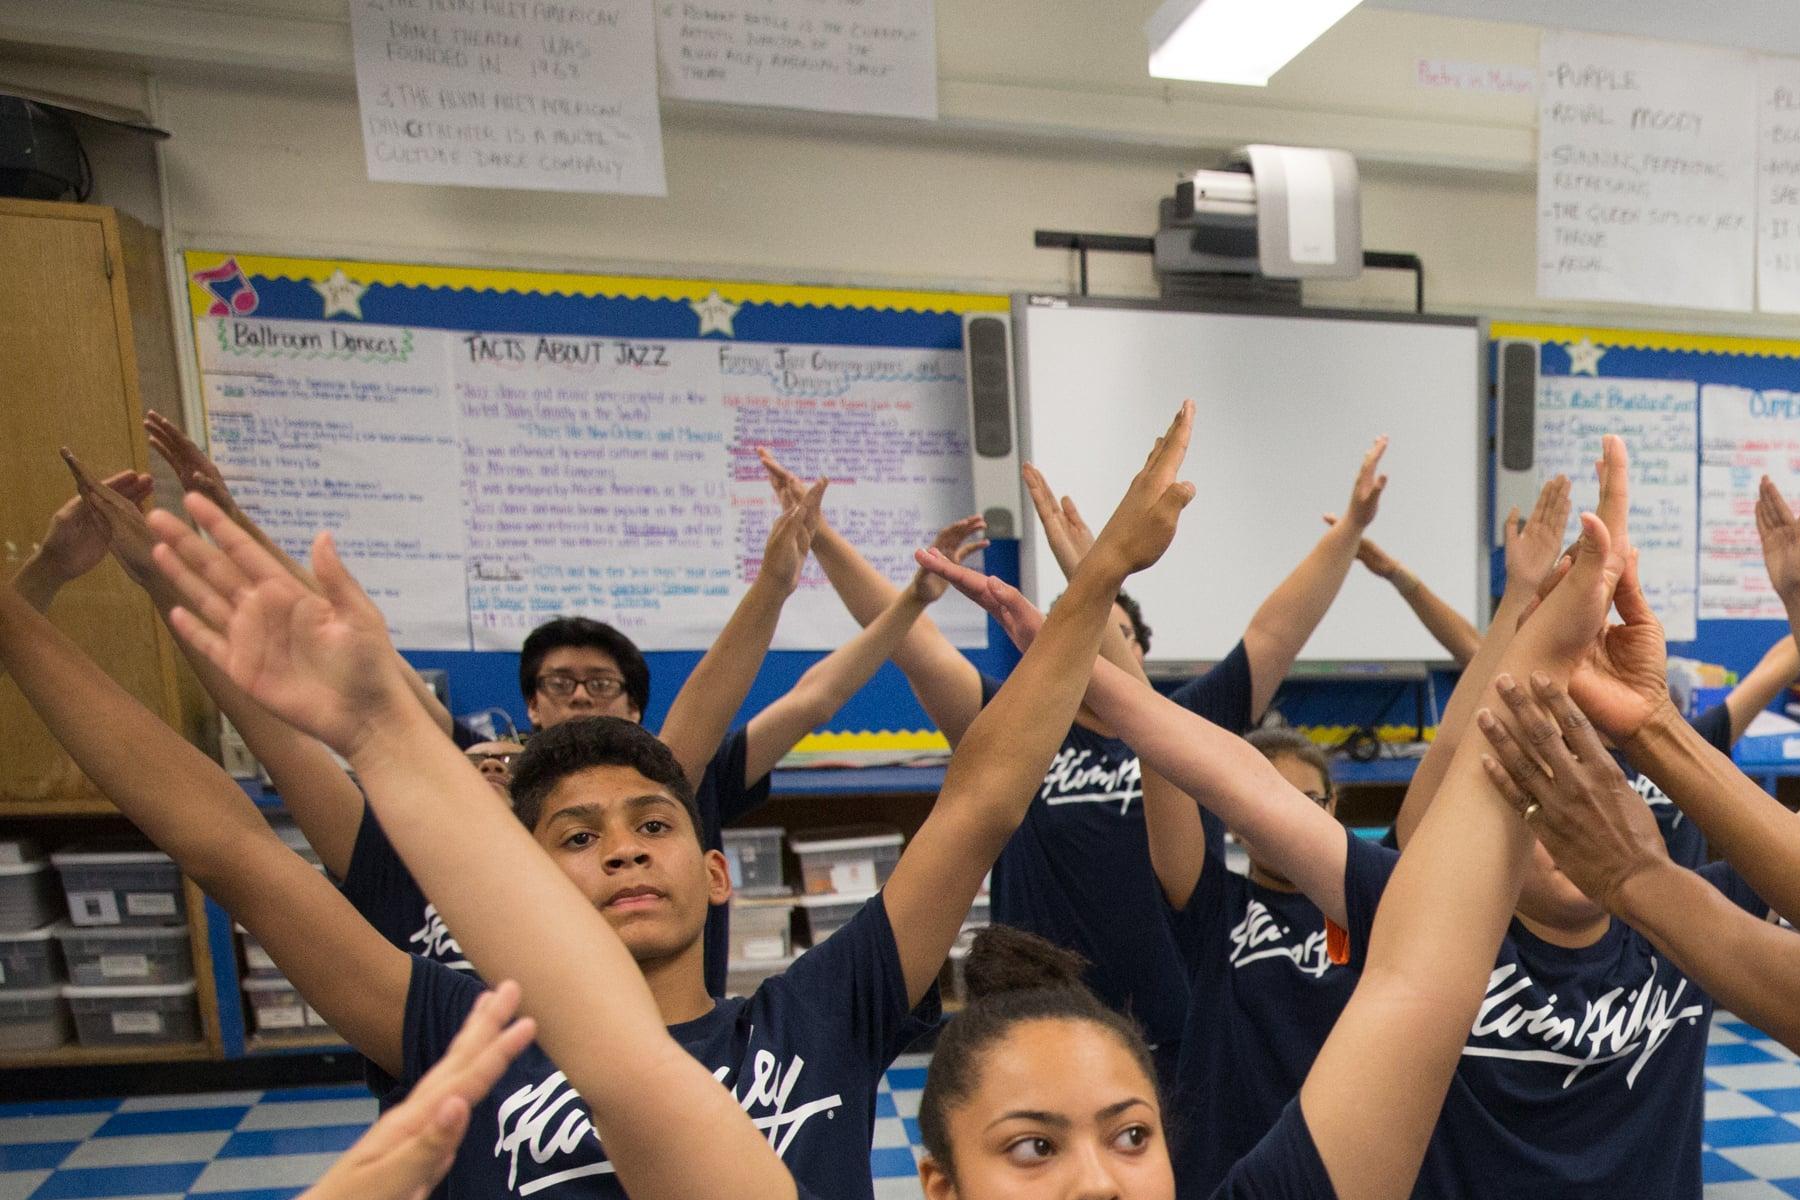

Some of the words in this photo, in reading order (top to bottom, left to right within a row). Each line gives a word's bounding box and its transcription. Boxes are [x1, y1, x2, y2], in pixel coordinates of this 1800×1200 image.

[233, 321, 322, 350] Ballroom
[462, 331, 526, 363] FACTS
[534, 334, 603, 364] ABOUT
[615, 341, 670, 368] JAZZ
